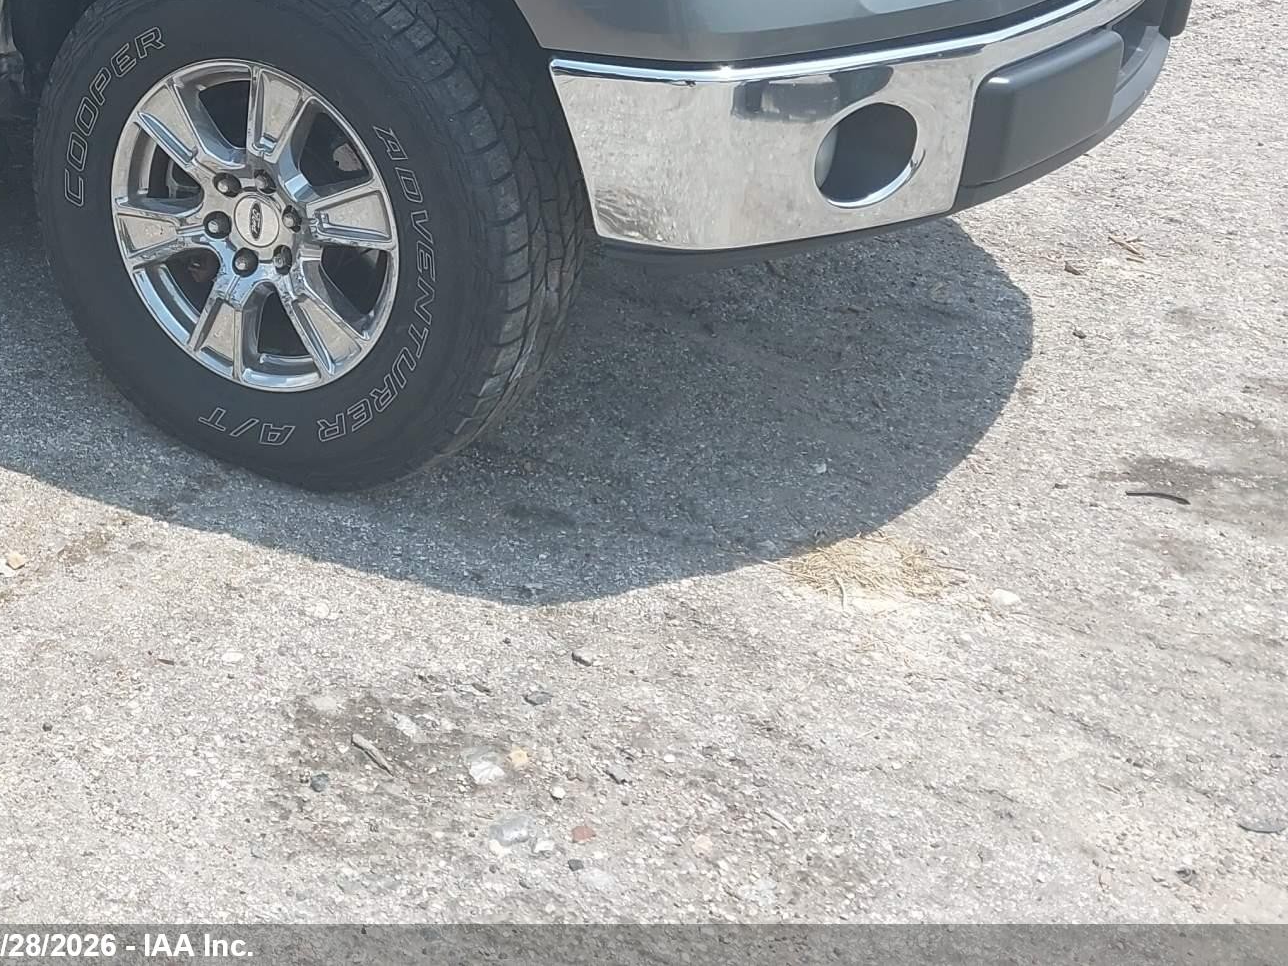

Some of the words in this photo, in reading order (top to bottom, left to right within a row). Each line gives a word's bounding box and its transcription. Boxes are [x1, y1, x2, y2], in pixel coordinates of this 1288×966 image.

[64, 26, 165, 208] COOPER
[250, 207, 262, 235] Ford
[317, 125, 436, 442] ADVENTURER
[199, 406, 296, 446] A/T
